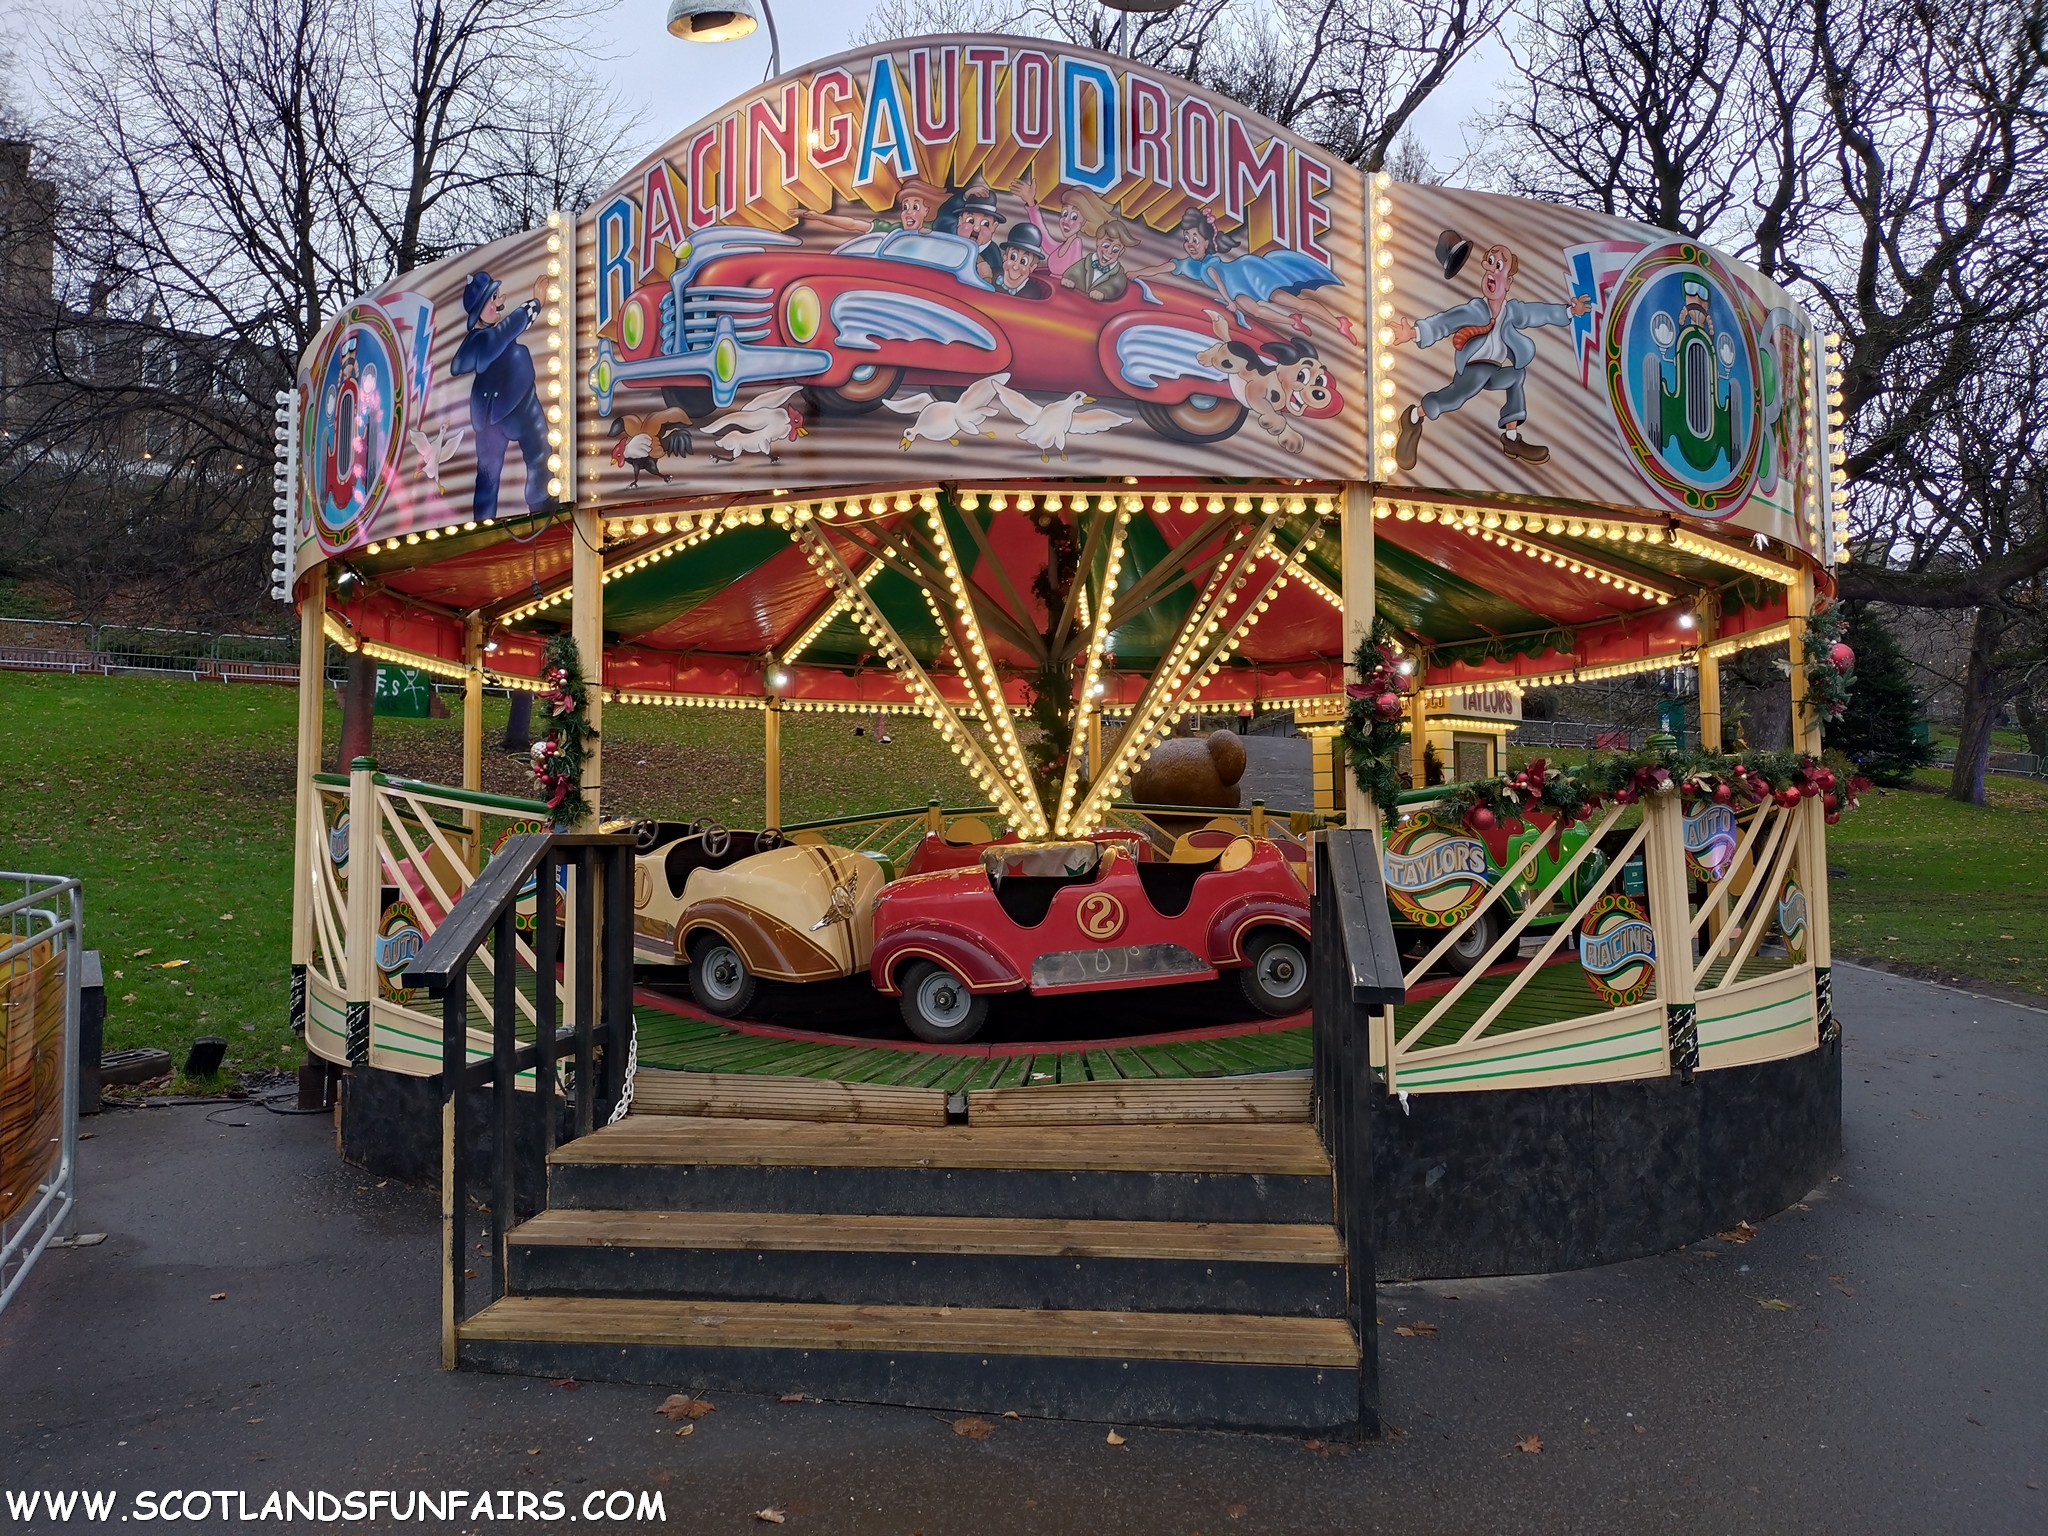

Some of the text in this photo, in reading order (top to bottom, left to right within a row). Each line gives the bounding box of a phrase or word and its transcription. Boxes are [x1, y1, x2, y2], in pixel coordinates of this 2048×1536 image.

[594, 66, 856, 336] RACING
[1687, 808, 1731, 846] AUTO
[1388, 841, 1486, 885] TAYLOR'S
[1086, 896, 1115, 934] 2
[381, 932, 419, 965] AUTO
[1585, 926, 1653, 967] RACING
